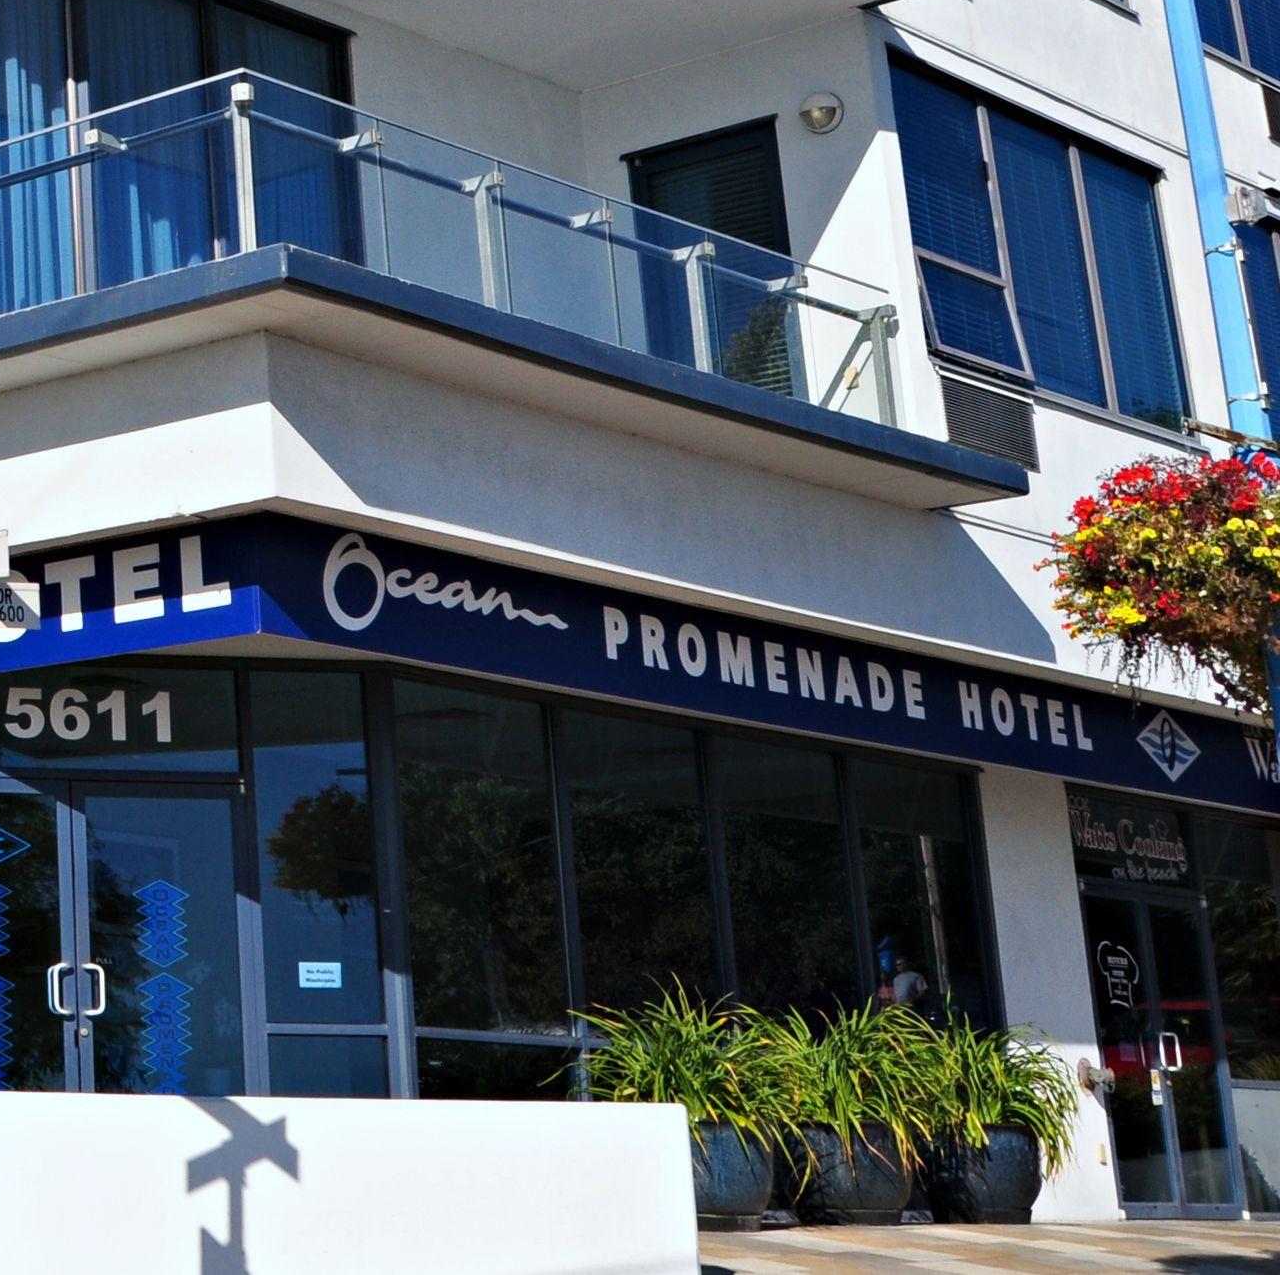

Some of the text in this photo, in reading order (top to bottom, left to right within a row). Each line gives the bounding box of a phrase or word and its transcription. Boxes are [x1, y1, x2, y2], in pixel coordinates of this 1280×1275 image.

[323, 532, 1094, 752] Ocean PROMENADE HOTEL
